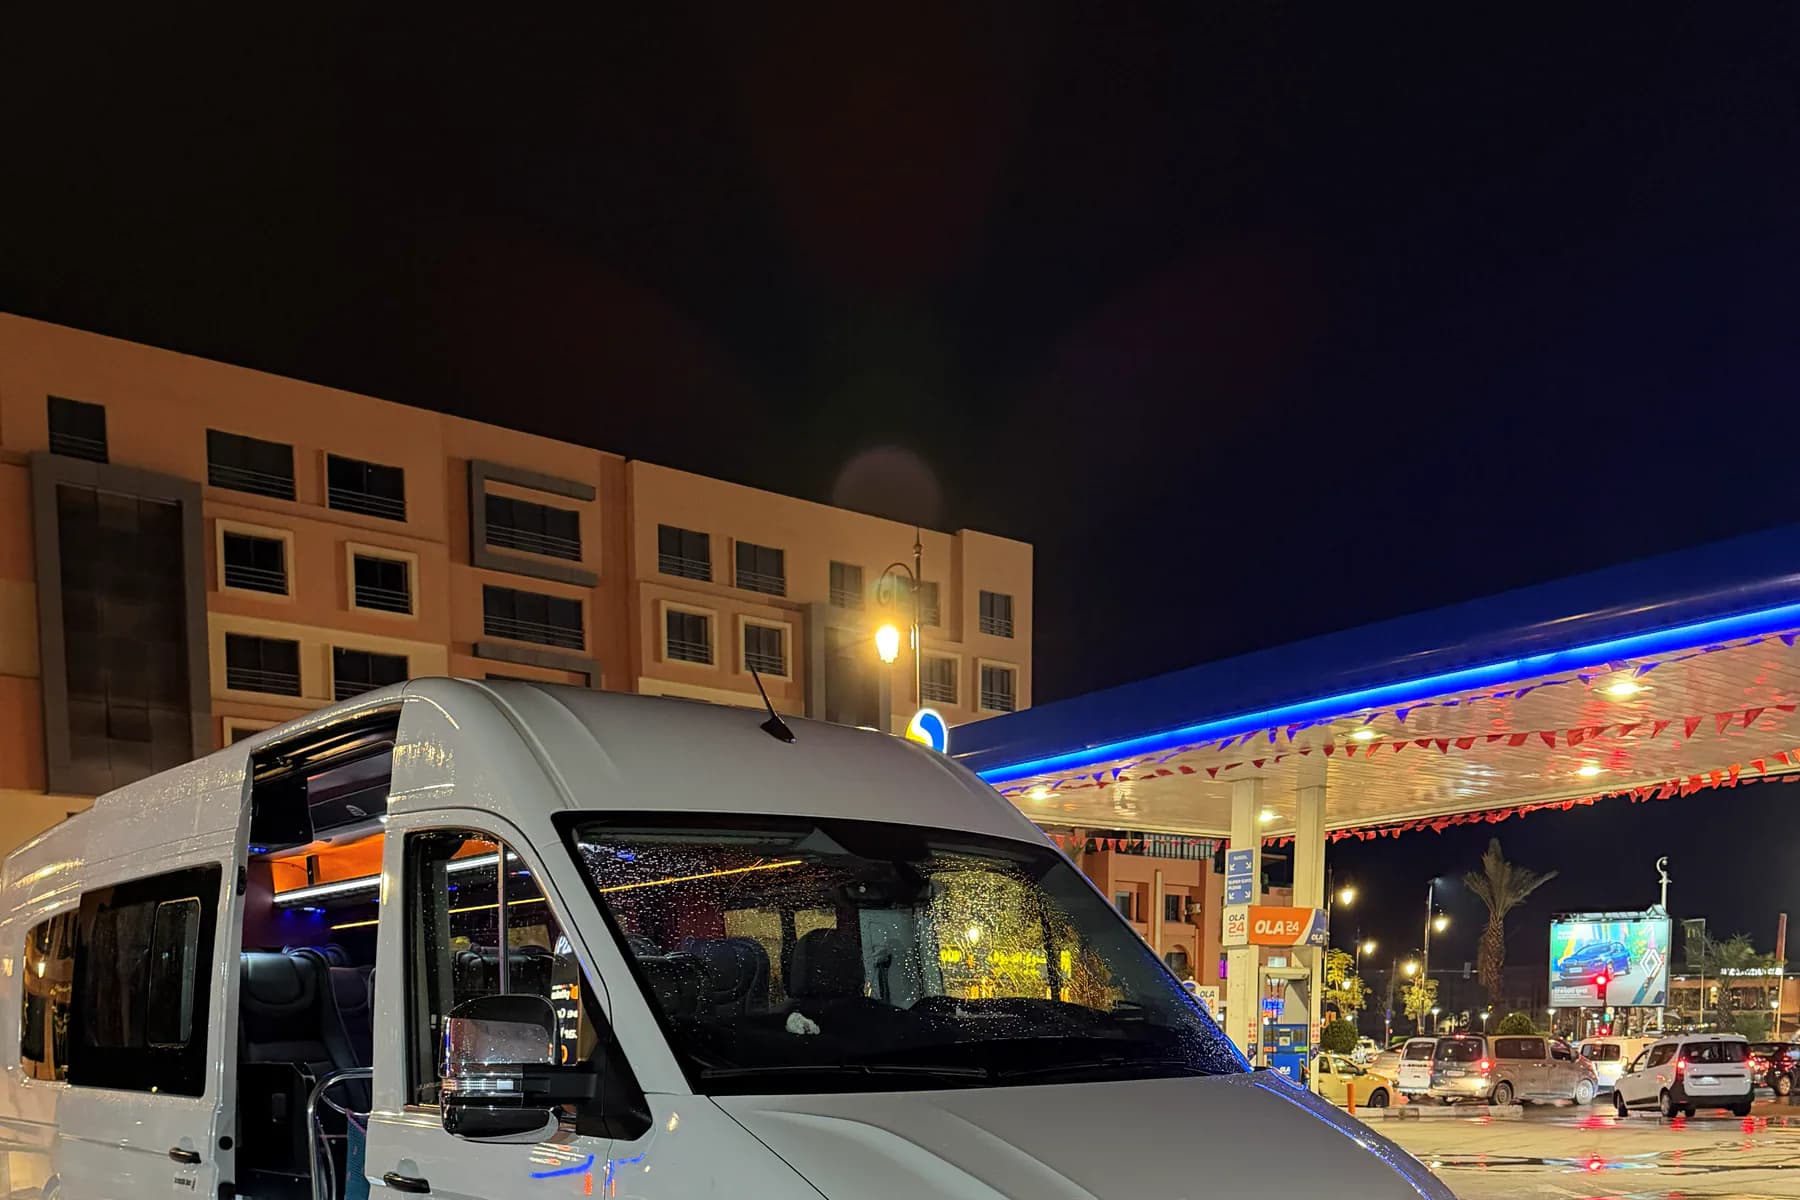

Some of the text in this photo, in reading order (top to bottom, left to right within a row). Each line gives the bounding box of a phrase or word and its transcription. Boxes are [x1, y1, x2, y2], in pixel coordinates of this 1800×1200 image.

[1228, 913, 1245, 922] OLA
[1228, 921, 1245, 934] 24
[1254, 919, 1300, 936] OLA 24
[1199, 990, 1215, 998] OLA
